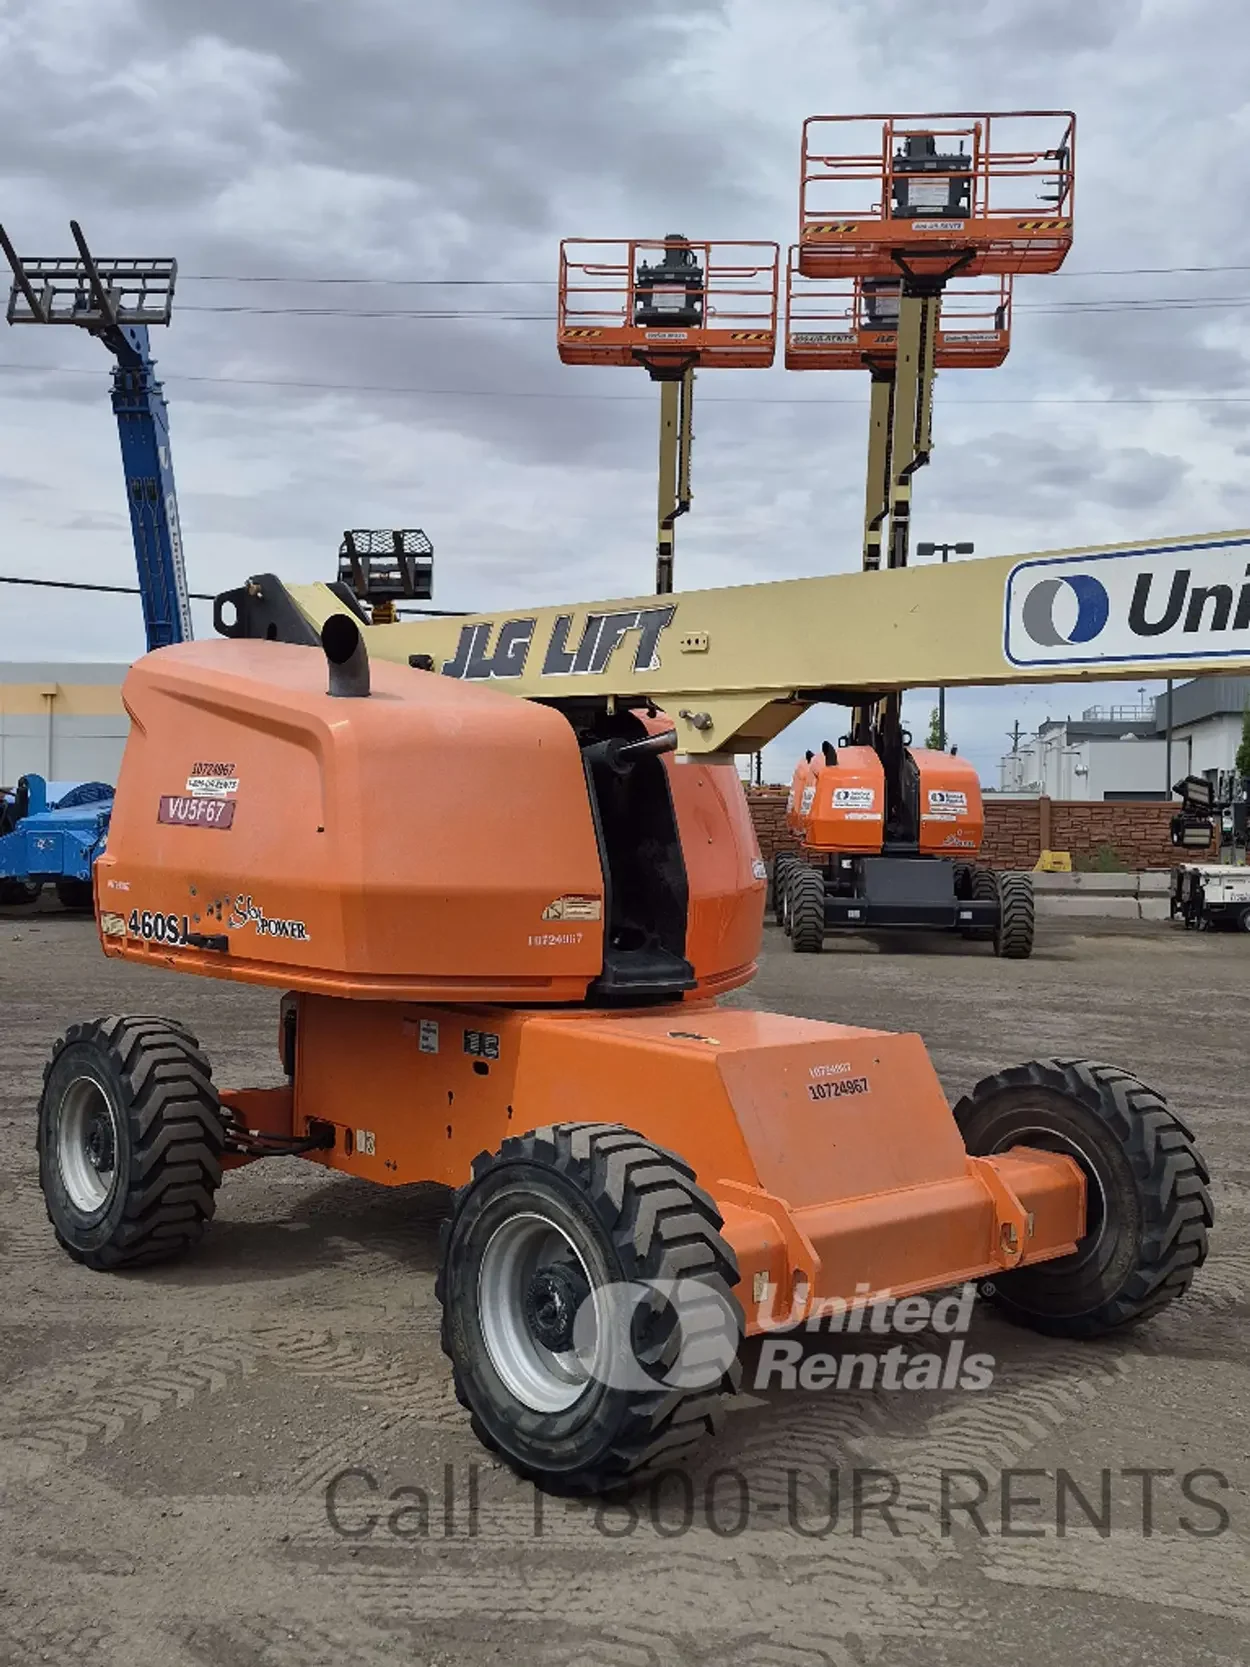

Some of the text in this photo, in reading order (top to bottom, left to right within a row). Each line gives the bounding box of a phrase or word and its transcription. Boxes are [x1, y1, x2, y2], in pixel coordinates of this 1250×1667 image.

[440, 602, 679, 680] JLG LIFT
[191, 762, 236, 776] 10724967
[168, 797, 226, 822] VU5F67
[808, 1078, 869, 1100] 10724967
